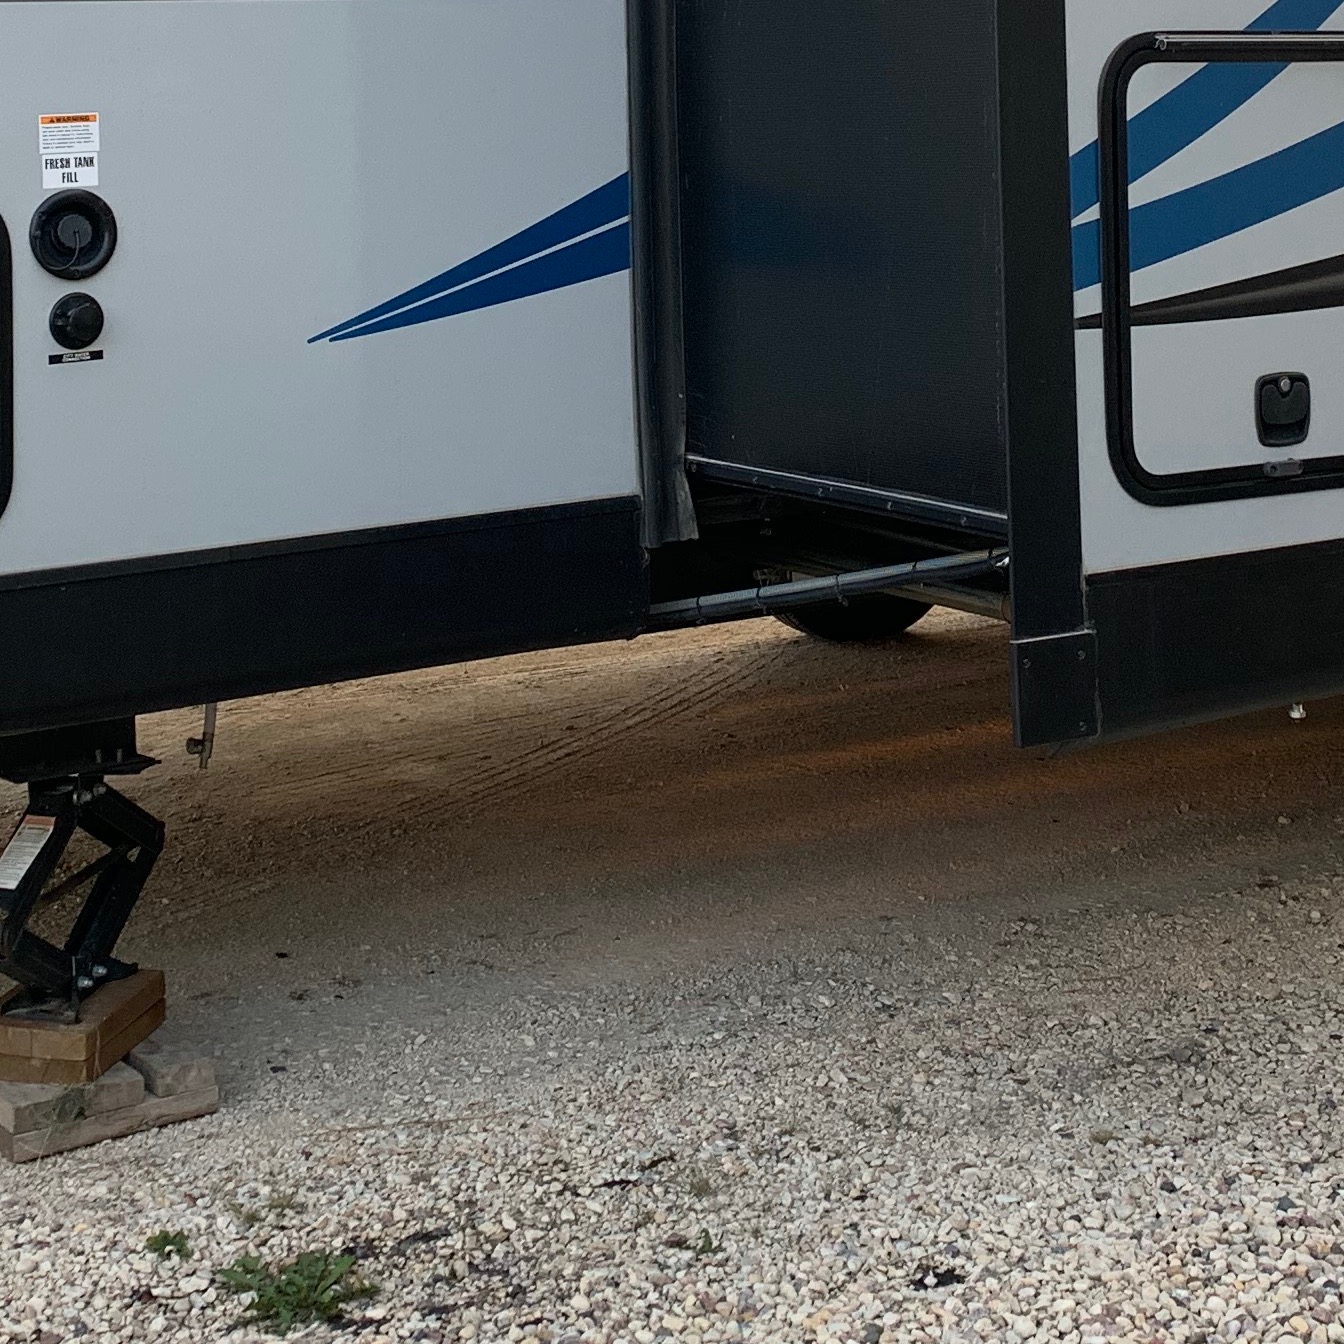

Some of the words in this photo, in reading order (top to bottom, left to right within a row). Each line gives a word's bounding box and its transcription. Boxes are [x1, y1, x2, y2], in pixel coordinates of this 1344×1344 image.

[44, 157, 71, 170] FRESH
[73, 156, 95, 167] TANK
[61, 172, 79, 183] FILL
